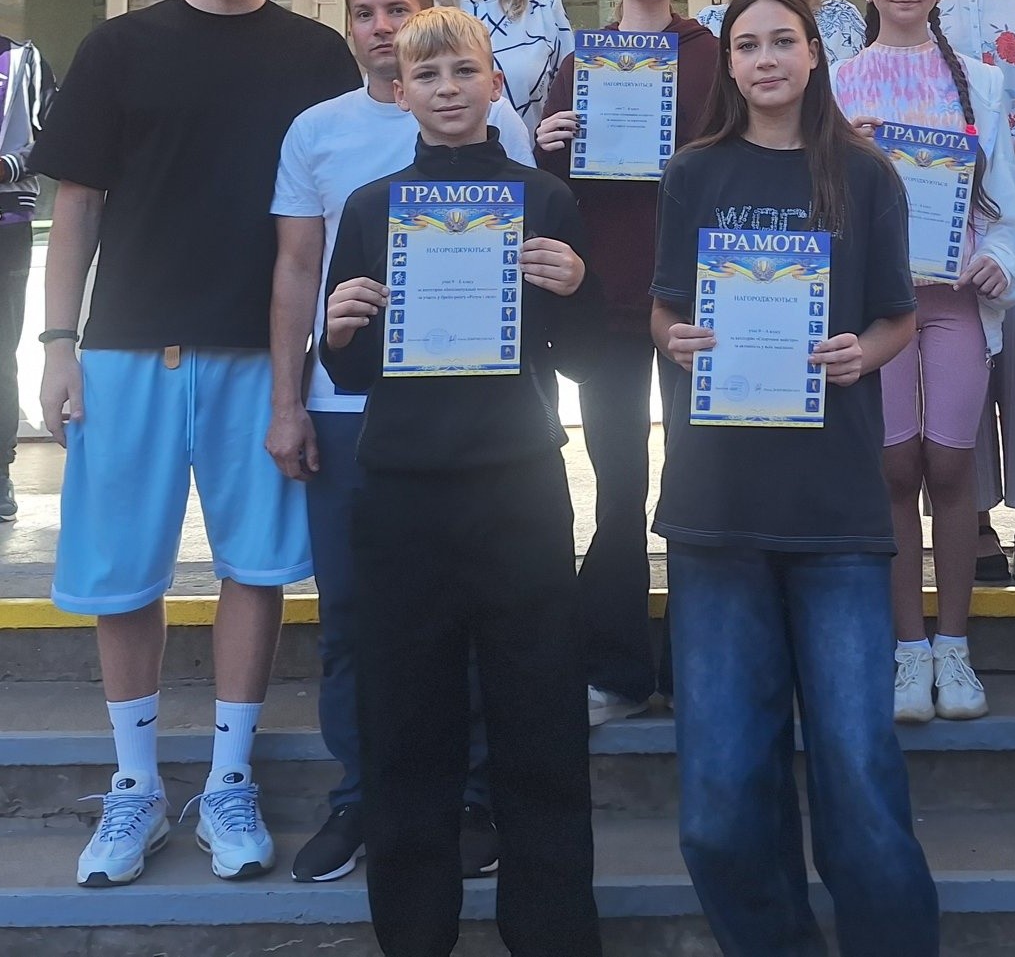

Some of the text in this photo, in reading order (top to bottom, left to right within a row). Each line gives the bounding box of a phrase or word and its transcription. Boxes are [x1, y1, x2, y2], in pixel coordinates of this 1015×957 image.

[582, 33, 671, 49] ГРАМОТА
[882, 124, 970, 151] ГРАМОТА
[400, 185, 515, 203] ГРАМОТА
[708, 232, 821, 253] ГРАМОТА
